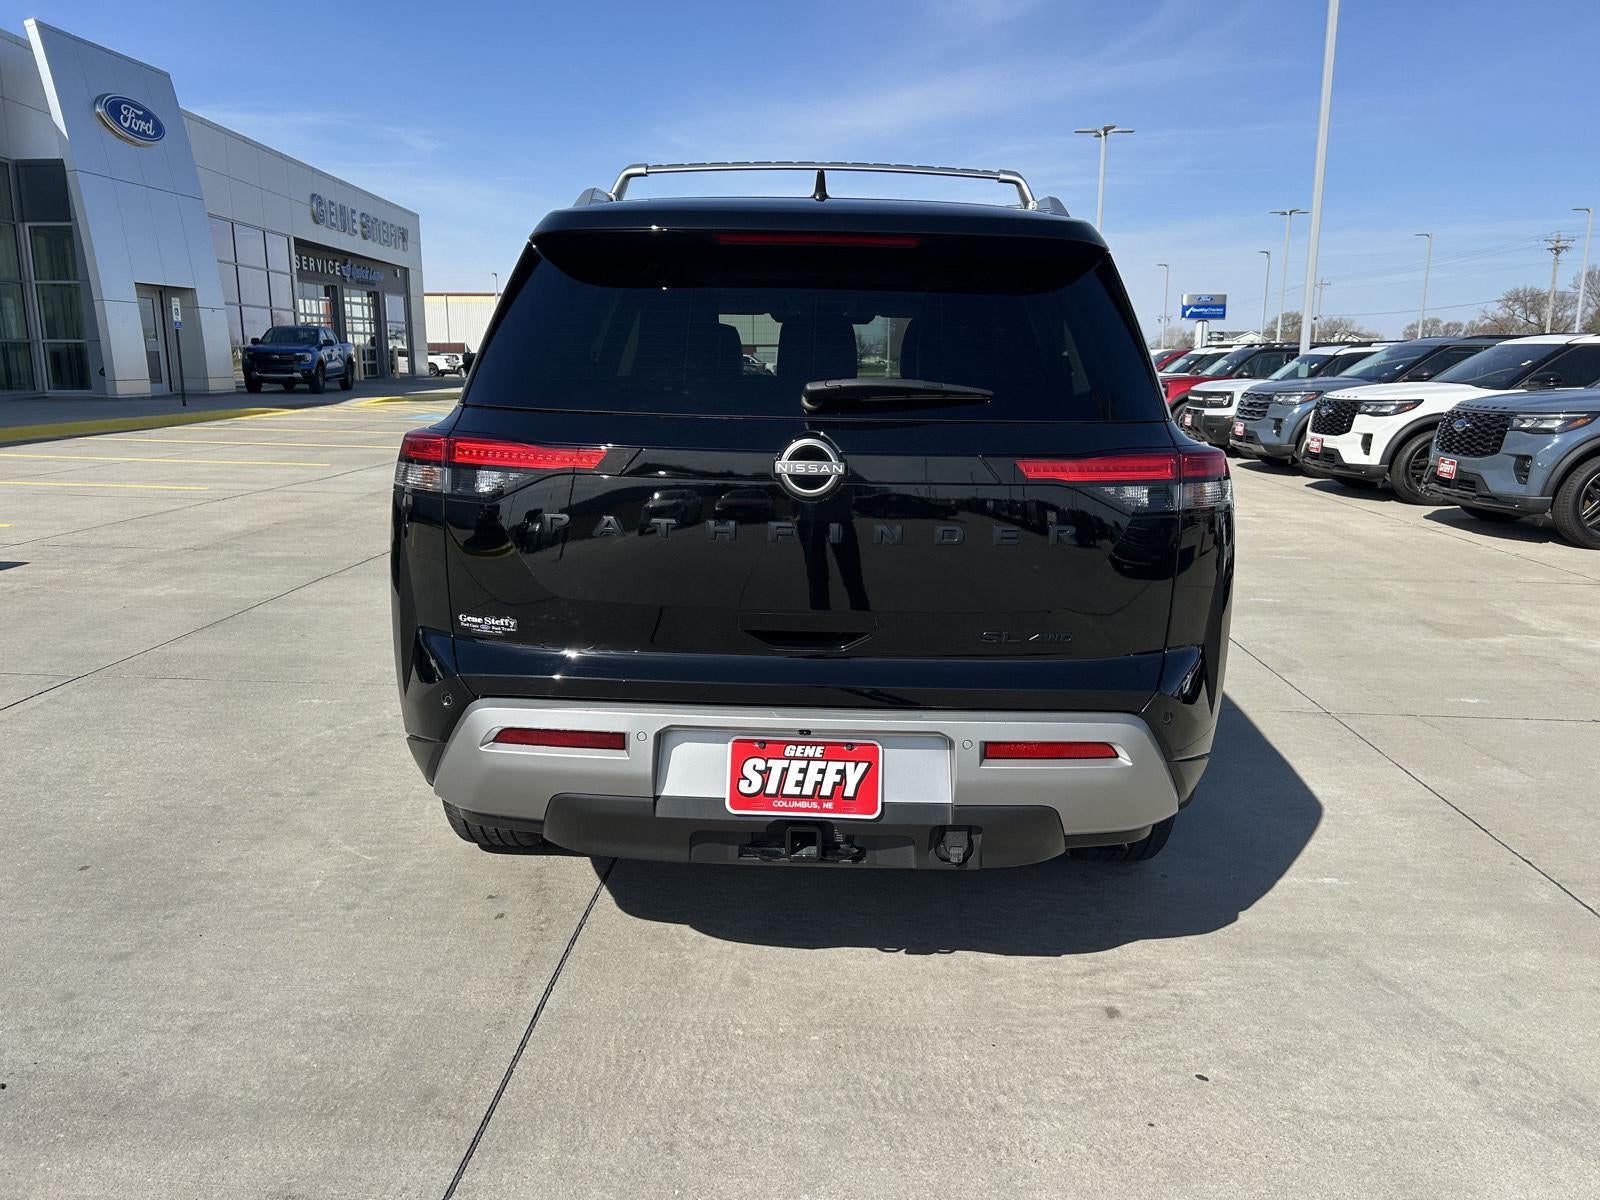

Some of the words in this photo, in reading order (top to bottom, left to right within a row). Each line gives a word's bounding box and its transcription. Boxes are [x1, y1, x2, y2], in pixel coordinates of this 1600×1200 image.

[120, 103, 155, 136] Ford
[311, 193, 358, 236] GENE
[359, 212, 409, 252] STEFFY
[294, 253, 341, 275] SERVICE
[777, 463, 843, 473] NISSAN
[540, 512, 1080, 546] PATHFINDER
[459, 614, 483, 623] Gene
[484, 616, 516, 628] Steffy
[981, 631, 1021, 643] SL
[783, 744, 826, 758] GENE
[738, 757, 870, 799] STEFFY
[772, 800, 820, 809] COLUMBUS,
